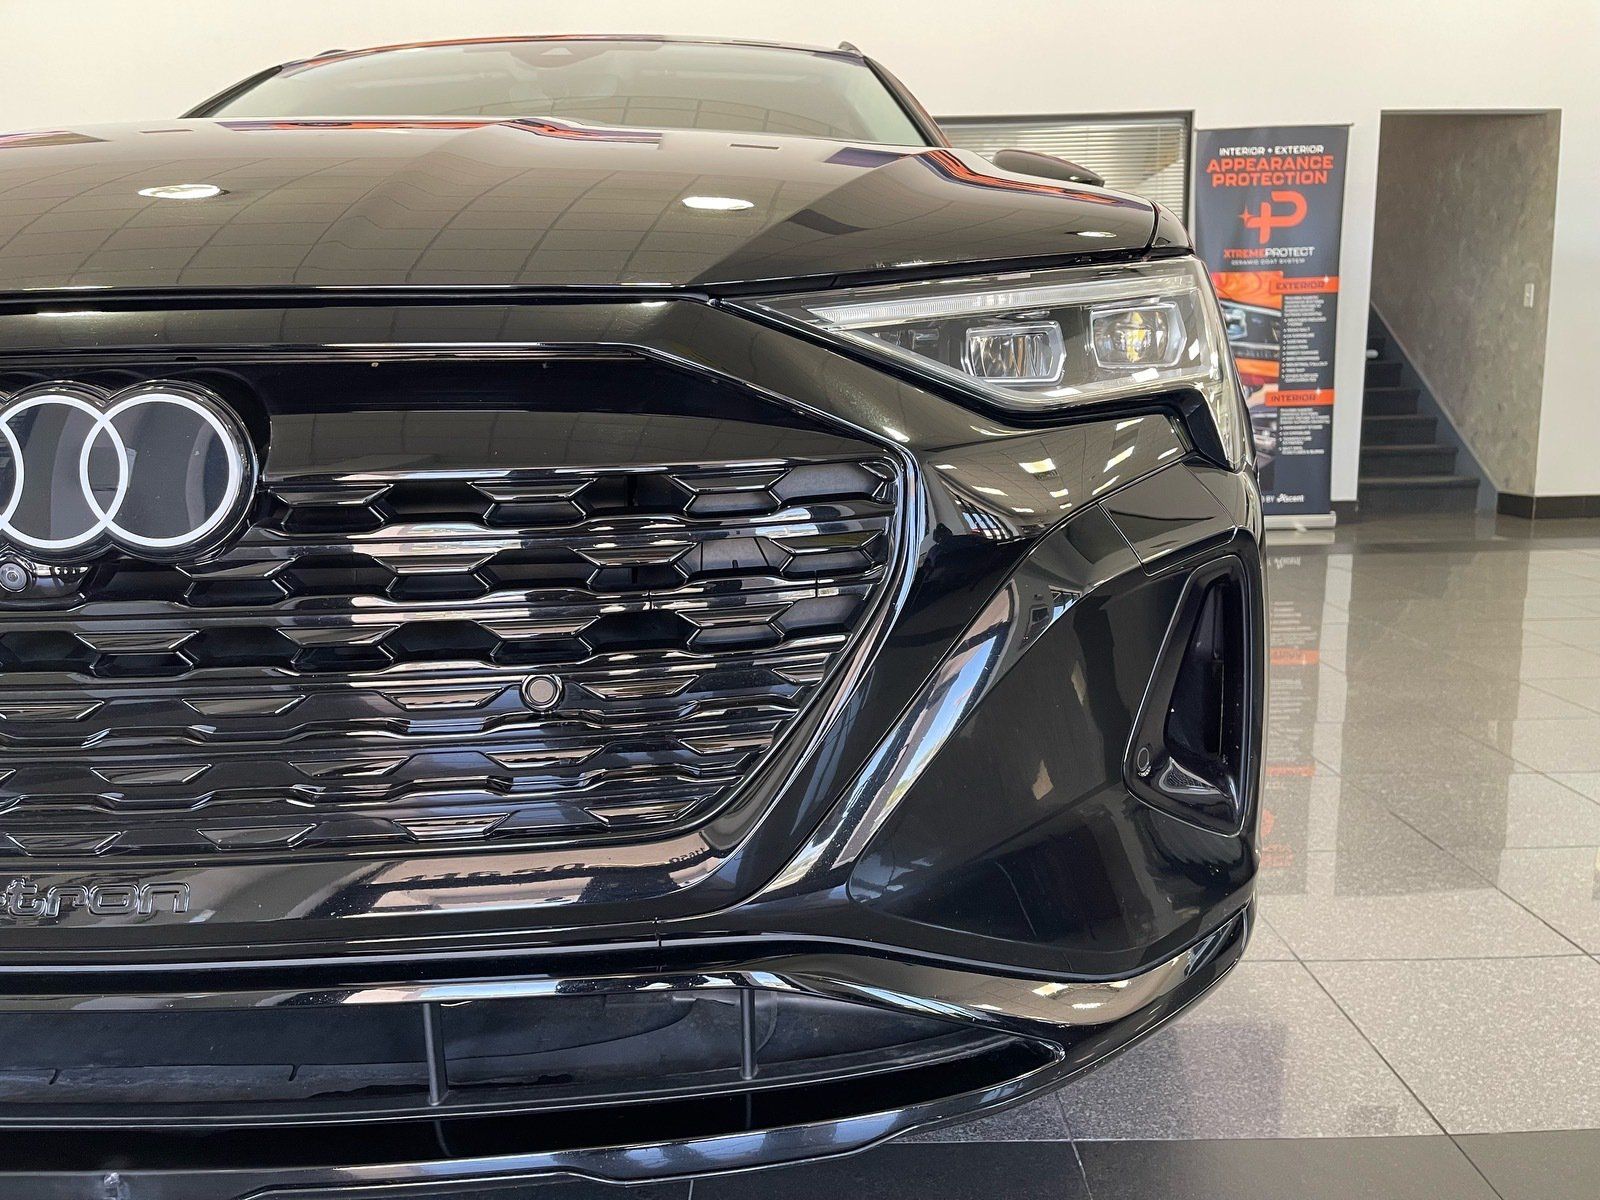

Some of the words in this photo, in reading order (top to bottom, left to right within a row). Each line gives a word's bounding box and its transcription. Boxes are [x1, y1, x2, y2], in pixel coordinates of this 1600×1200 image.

[1219, 146, 1266, 156] INTERIOR
[1274, 145, 1325, 155] EXTERIOR
[1206, 156, 1334, 173] APPEARANCE
[1212, 170, 1328, 187] PROTECTION
[1231, 258, 1259, 266] CERAMIC
[1276, 280, 1325, 290] EXTERIOR
[1271, 394, 1315, 402] INTERIOR
